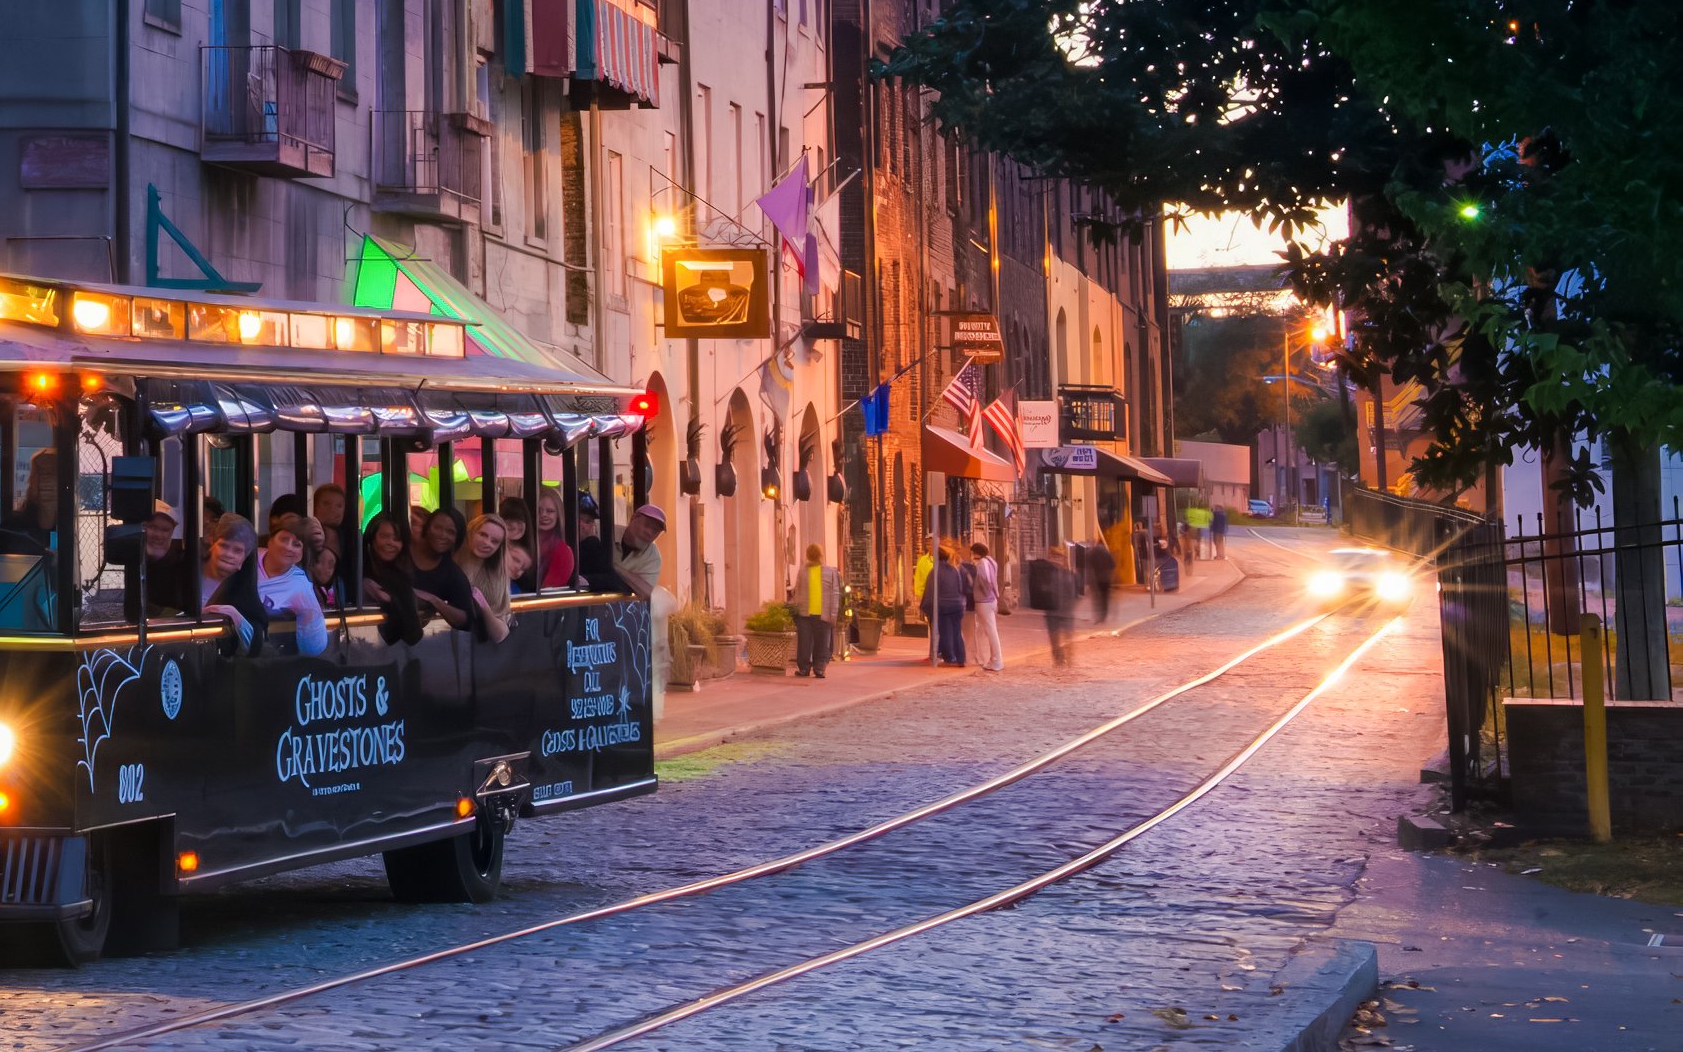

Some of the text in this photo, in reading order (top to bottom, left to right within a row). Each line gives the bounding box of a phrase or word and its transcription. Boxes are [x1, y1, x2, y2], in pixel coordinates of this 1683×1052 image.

[295, 673, 390, 726] GHOSTS &
[276, 718, 405, 788] GRAVESTONES
